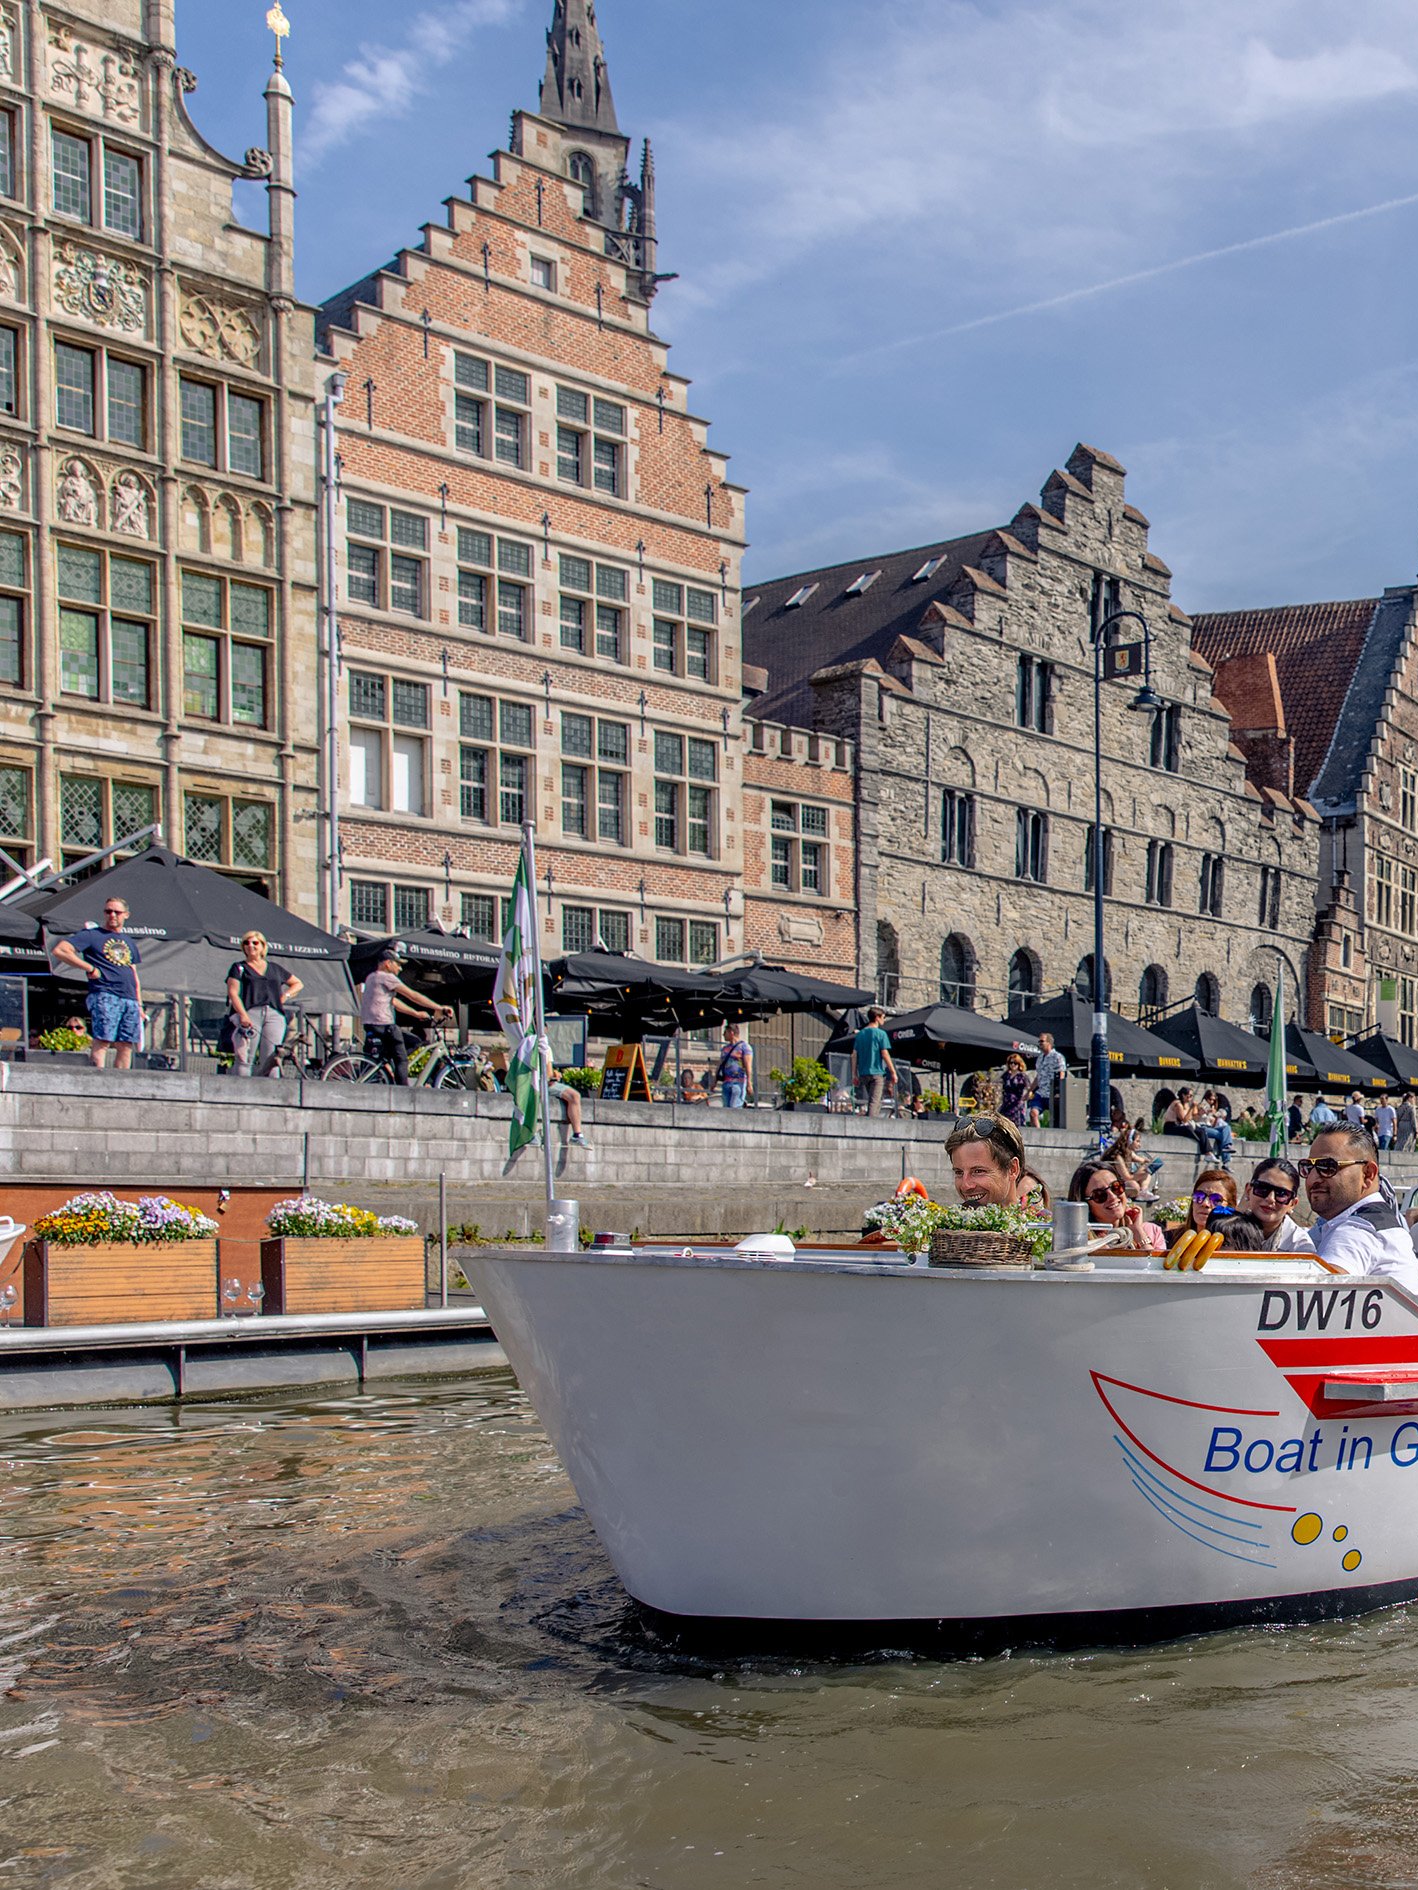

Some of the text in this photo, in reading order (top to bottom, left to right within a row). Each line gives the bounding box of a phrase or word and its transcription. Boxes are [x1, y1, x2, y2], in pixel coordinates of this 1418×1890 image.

[420, 946, 460, 959] massimo
[1258, 1289, 1384, 1331] DW16
[1203, 1427, 1323, 1474] Boat
[1335, 1426, 1374, 1471] in
